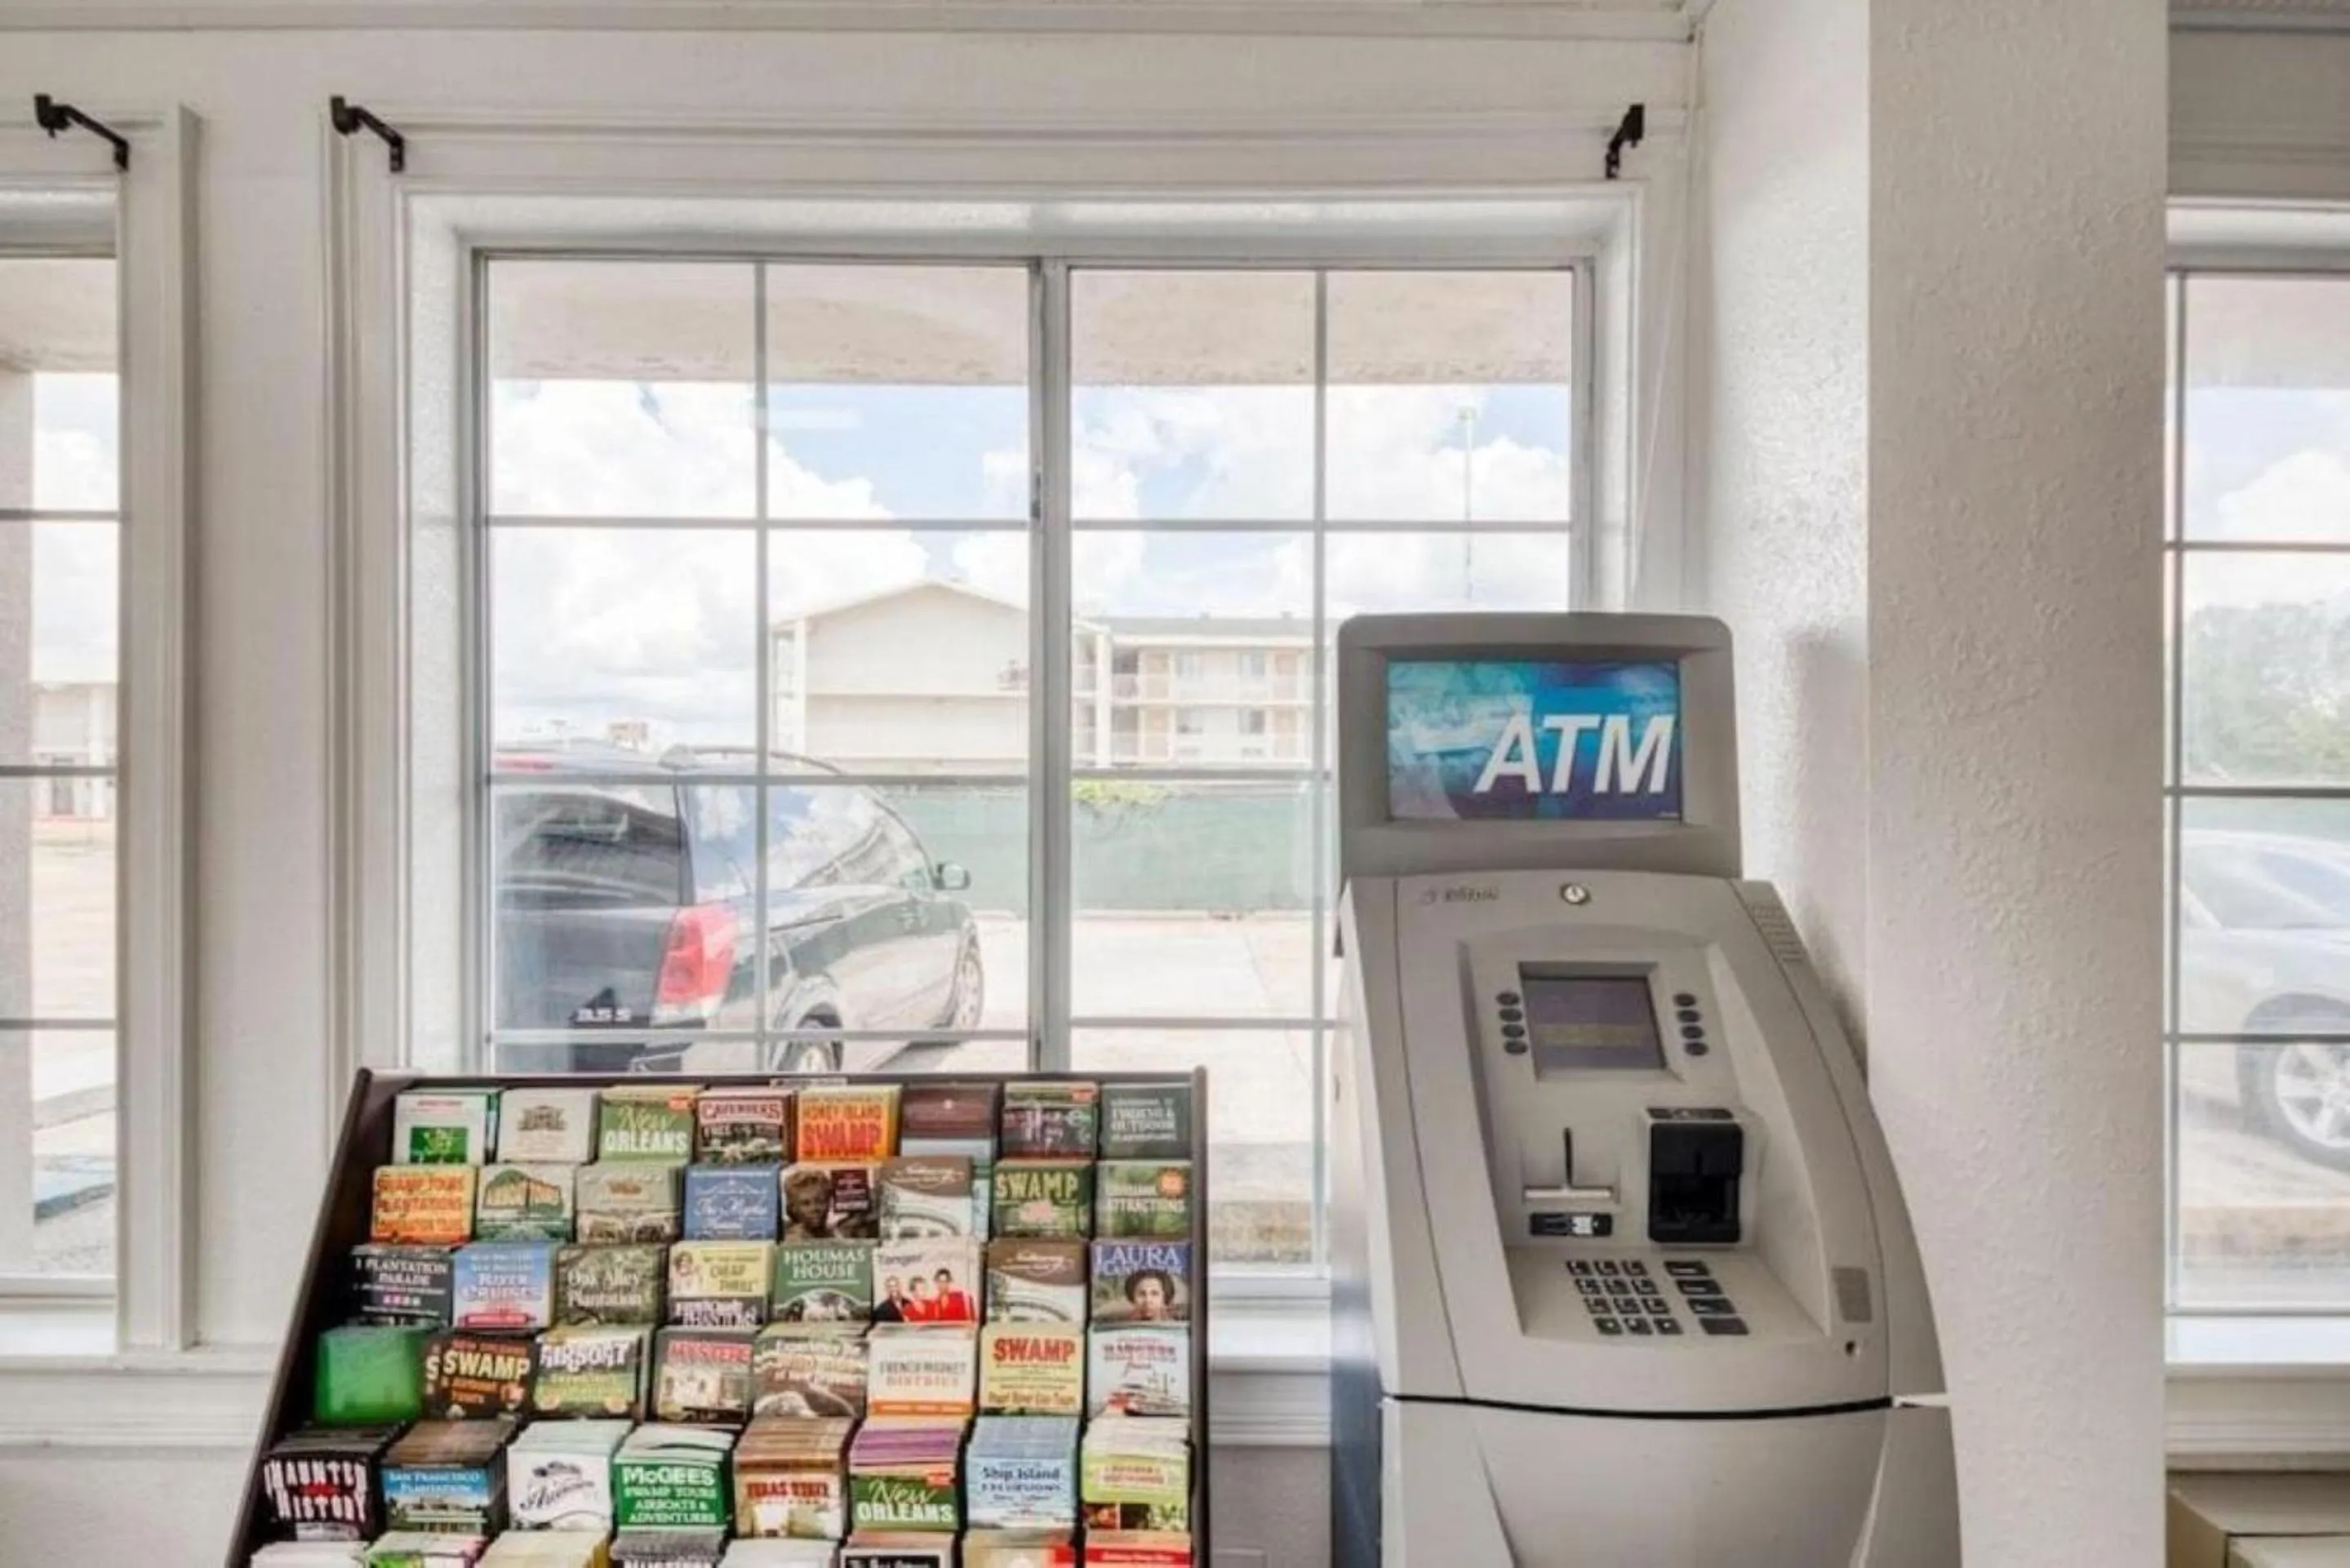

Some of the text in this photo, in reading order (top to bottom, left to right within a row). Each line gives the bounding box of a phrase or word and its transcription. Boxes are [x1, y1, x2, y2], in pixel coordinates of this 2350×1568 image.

[1473, 713, 1675, 794] ATM
[617, 1105, 677, 1131] New
[605, 1130, 688, 1153] ORLEANS
[802, 1121, 882, 1157] SWAMP
[995, 1171, 1078, 1199] SWAMP
[365, 1258, 448, 1274] PLANTATION
[784, 1248, 866, 1264] HOUMAS
[1095, 1246, 1180, 1266] LAURA
[604, 1269, 640, 1288] Alley
[792, 1264, 856, 1279] HOUSE
[993, 1337, 1076, 1363] SWAMP
[442, 1350, 531, 1382] SWAMP
[269, 1458, 367, 1490] HAUNTED
[1017, 1466, 1060, 1480] Island
[624, 1486, 671, 1498] SWAMP
[868, 1478, 937, 1504] New
[276, 1488, 366, 1523] HISTORY
[857, 1502, 953, 1522] ORLEANS
